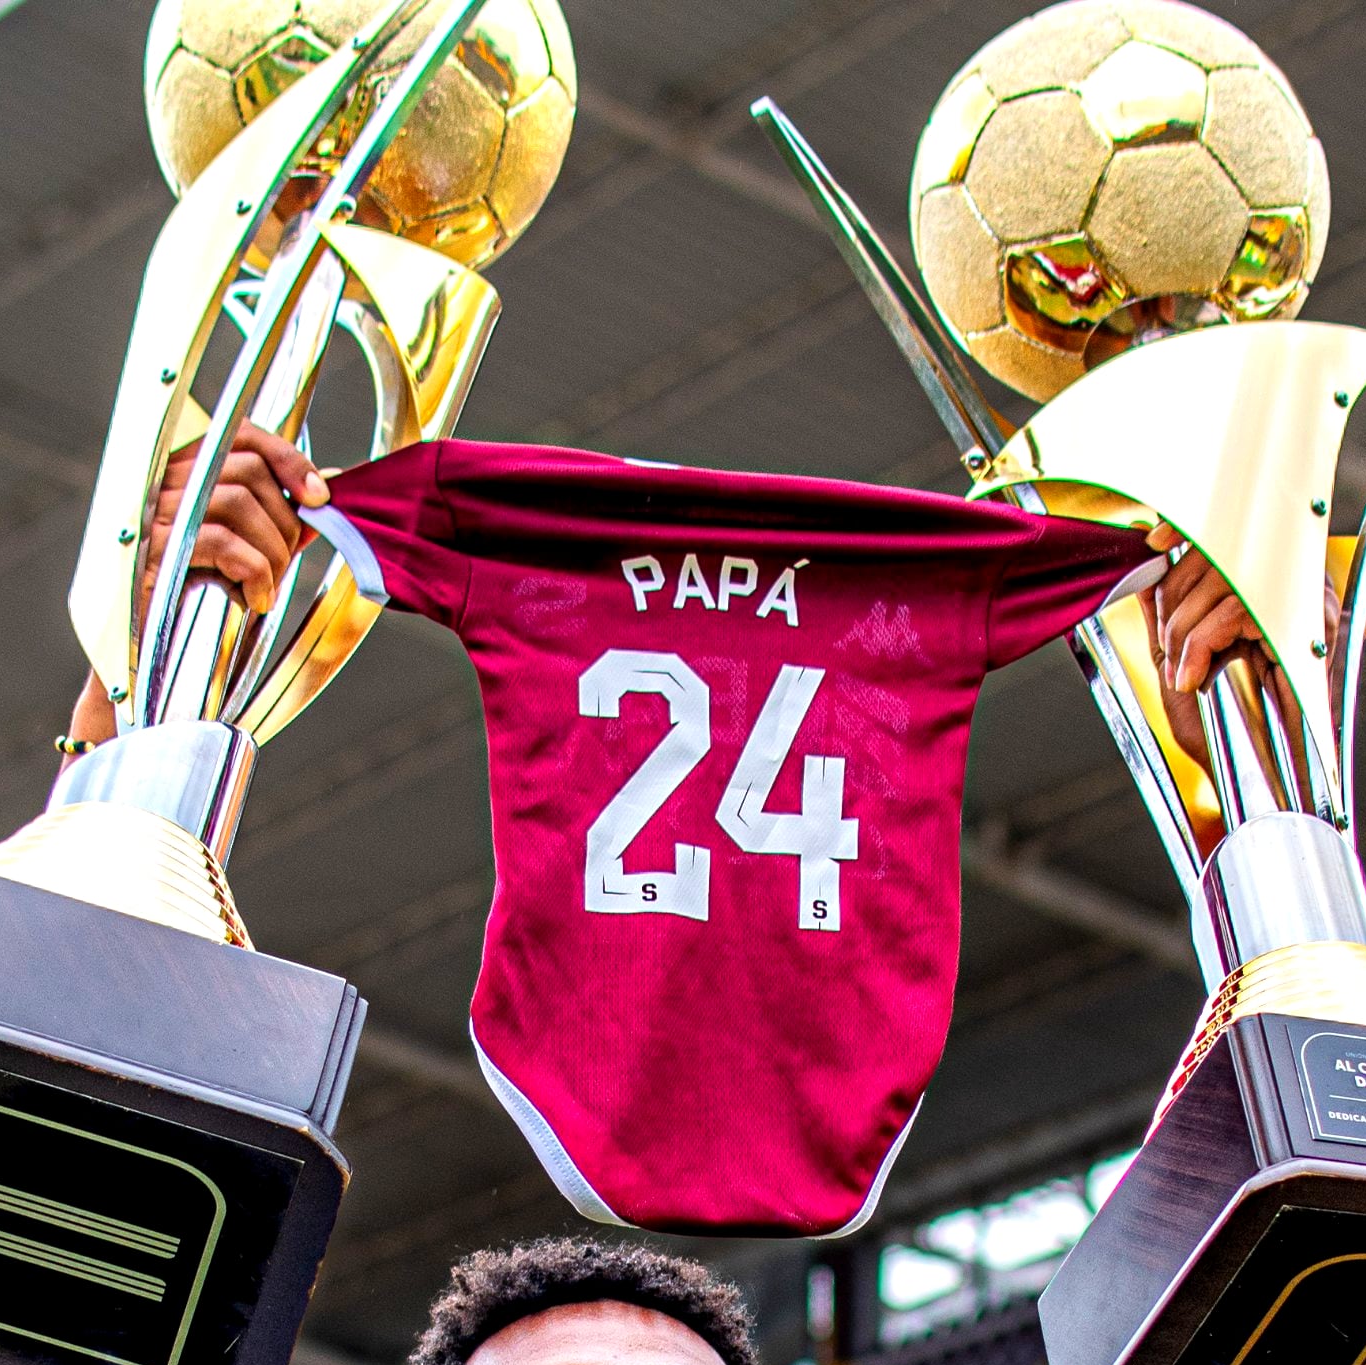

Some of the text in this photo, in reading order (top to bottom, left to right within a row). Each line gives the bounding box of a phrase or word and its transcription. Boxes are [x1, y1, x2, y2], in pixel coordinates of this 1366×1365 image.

[621, 553, 810, 627] PAPÁ
[578, 648, 859, 931] 24
[641, 883, 658, 902] S
[812, 899, 828, 919] S
[1335, 1059, 1356, 1073] AL
